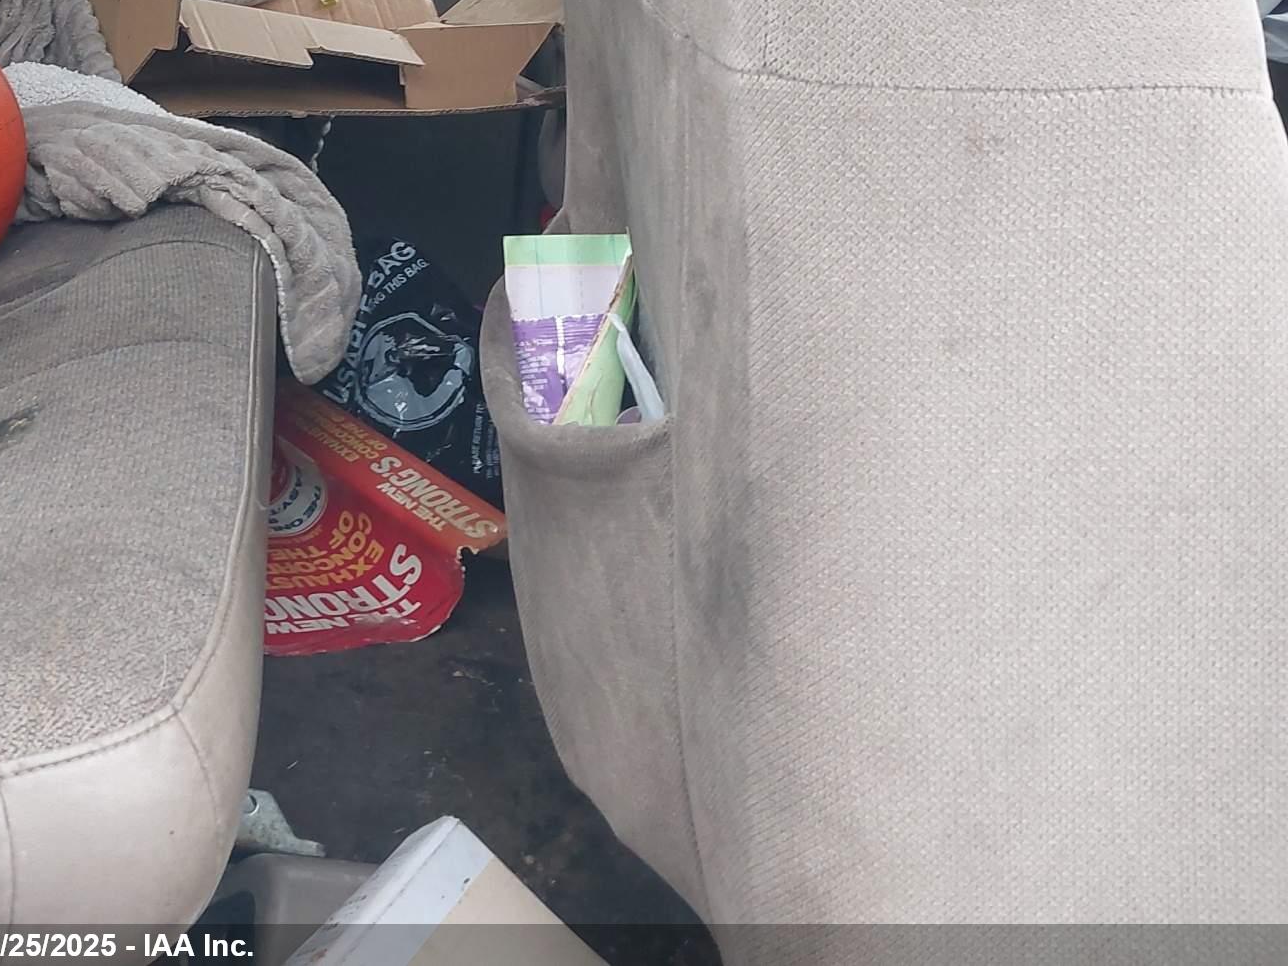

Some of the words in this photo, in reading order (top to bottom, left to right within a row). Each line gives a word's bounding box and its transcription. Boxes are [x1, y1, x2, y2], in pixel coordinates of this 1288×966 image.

[368, 241, 416, 289] BAG
[383, 273, 407, 295] THIS
[370, 456, 498, 538] STRONG'S
[375, 482, 418, 510] NEW
[329, 510, 354, 550] OF
[411, 505, 447, 532] THE
[266, 617, 350, 635] NEW
